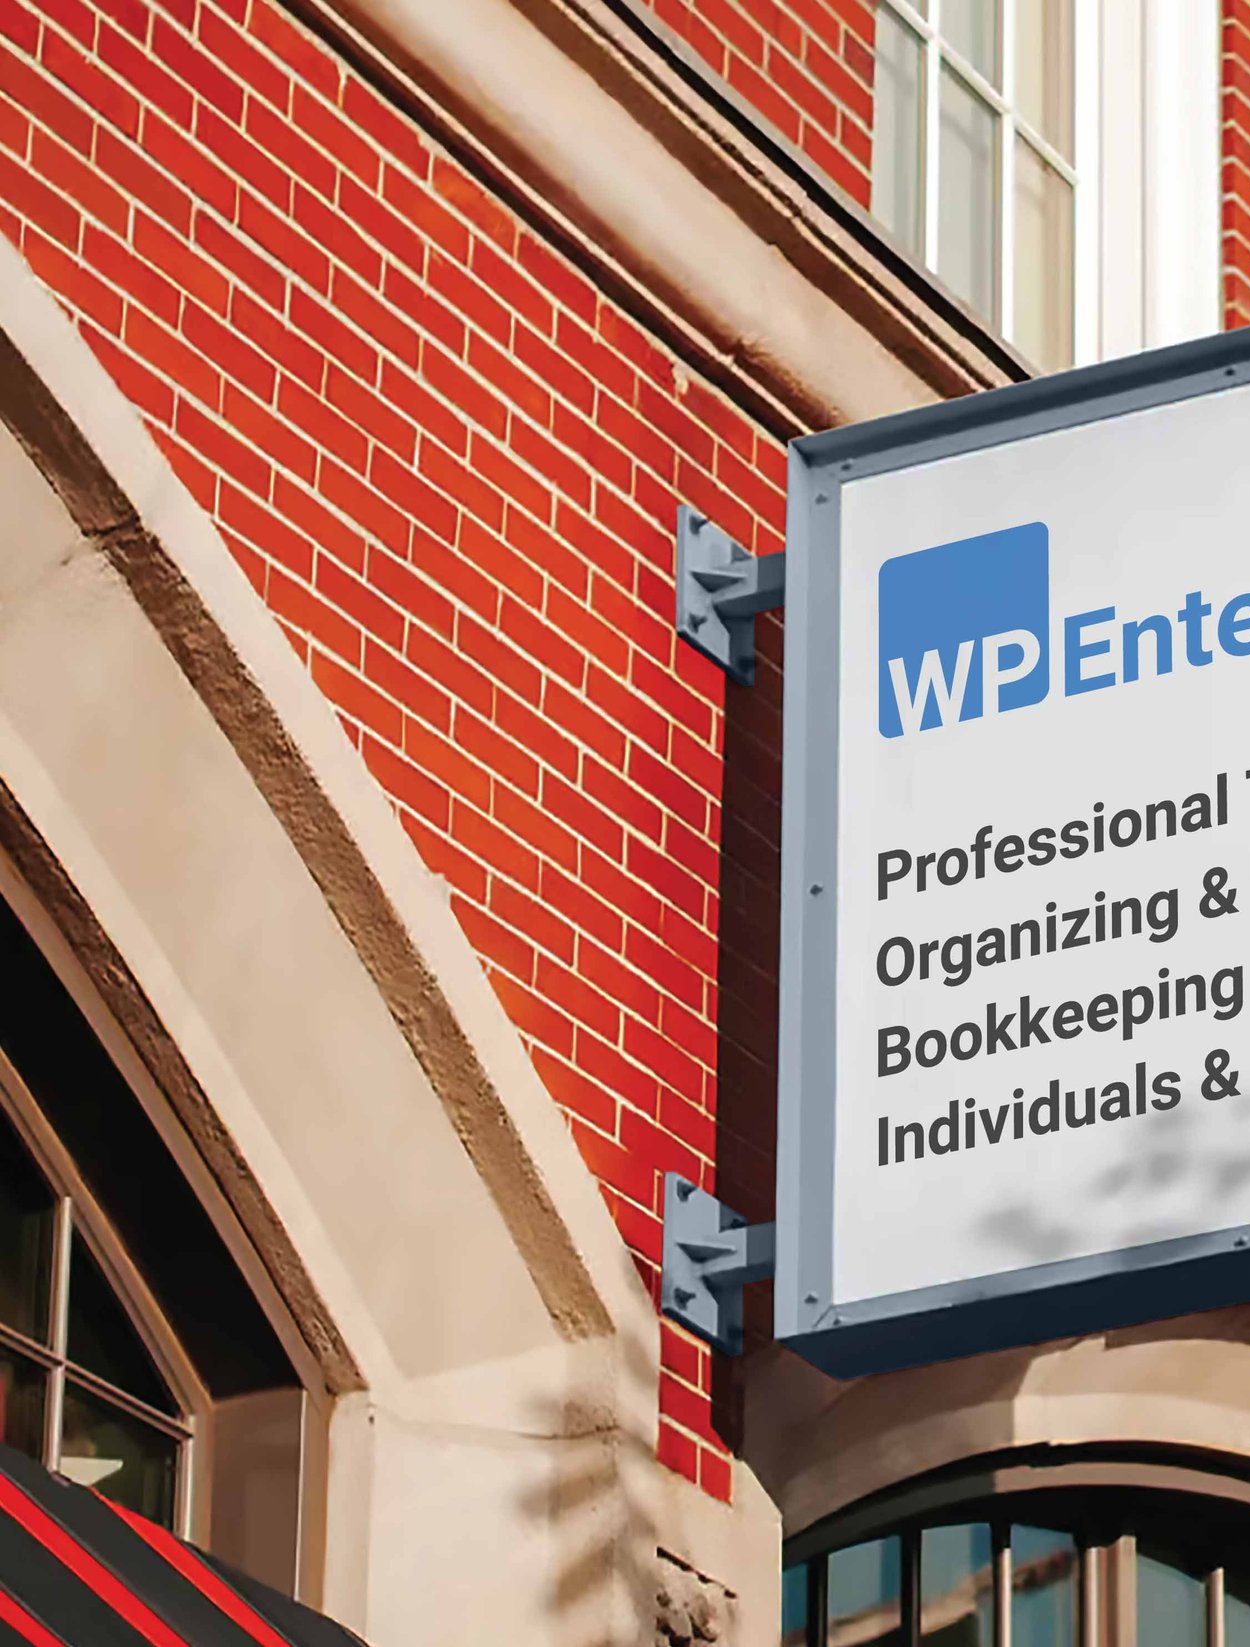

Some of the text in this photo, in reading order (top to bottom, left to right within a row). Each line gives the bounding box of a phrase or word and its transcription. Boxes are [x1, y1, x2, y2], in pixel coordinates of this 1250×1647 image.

[887, 628, 1041, 737] WP
[877, 772, 1228, 901] Professional
[876, 888, 1179, 987] Organizing
[1199, 866, 1240, 919] &
[877, 965, 1244, 1078] Bookkeeping
[878, 1061, 1181, 1167] Individuals
[1200, 1048, 1241, 1101] &
